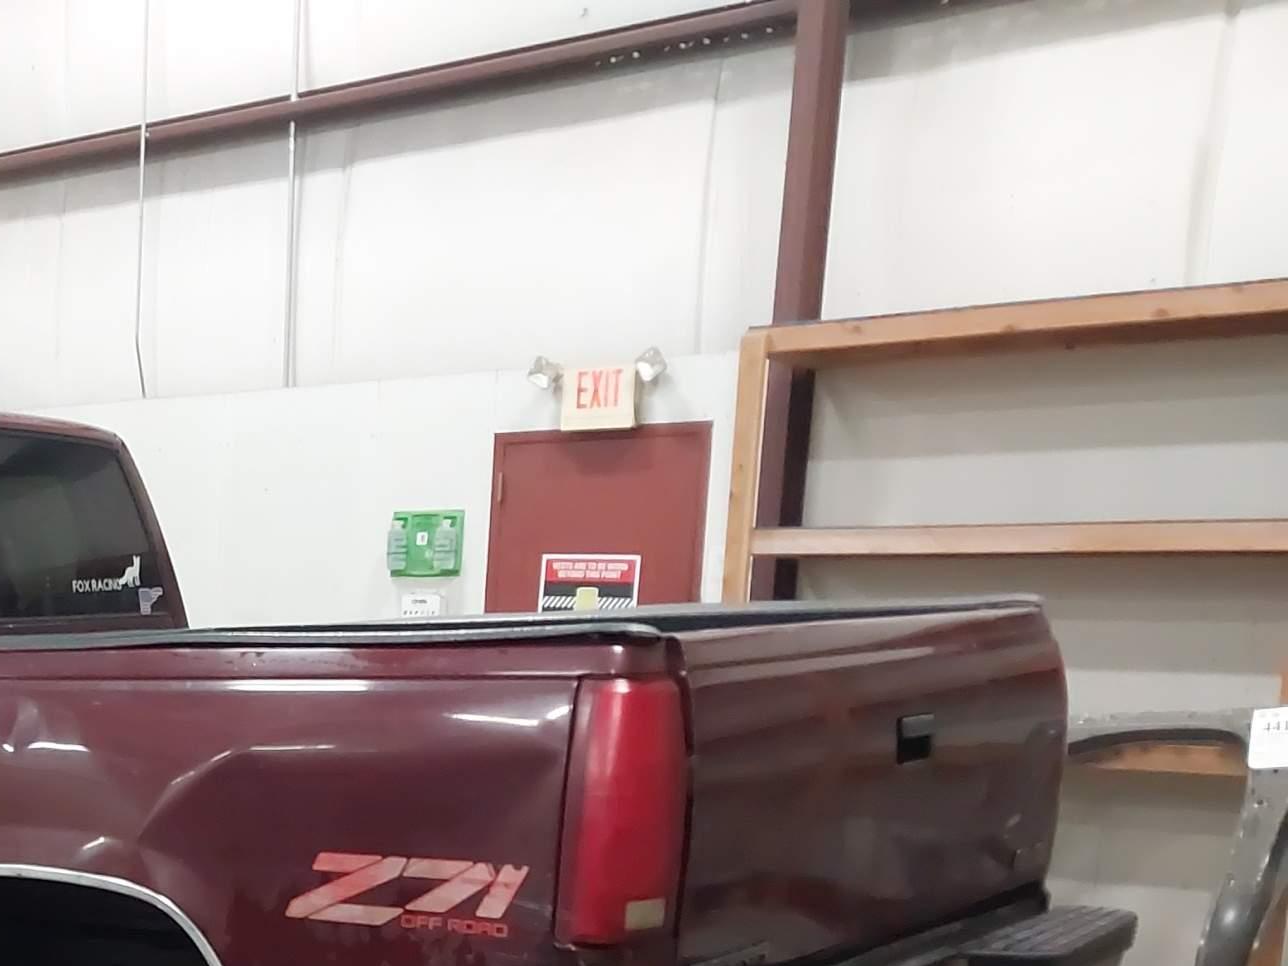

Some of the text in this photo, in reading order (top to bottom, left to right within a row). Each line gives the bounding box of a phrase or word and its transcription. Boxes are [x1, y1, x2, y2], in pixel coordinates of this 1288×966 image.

[576, 368, 624, 409] EXIT
[72, 579, 91, 593] FOX
[285, 852, 530, 926] Z71
[401, 914, 508, 938] OFF ROAD
